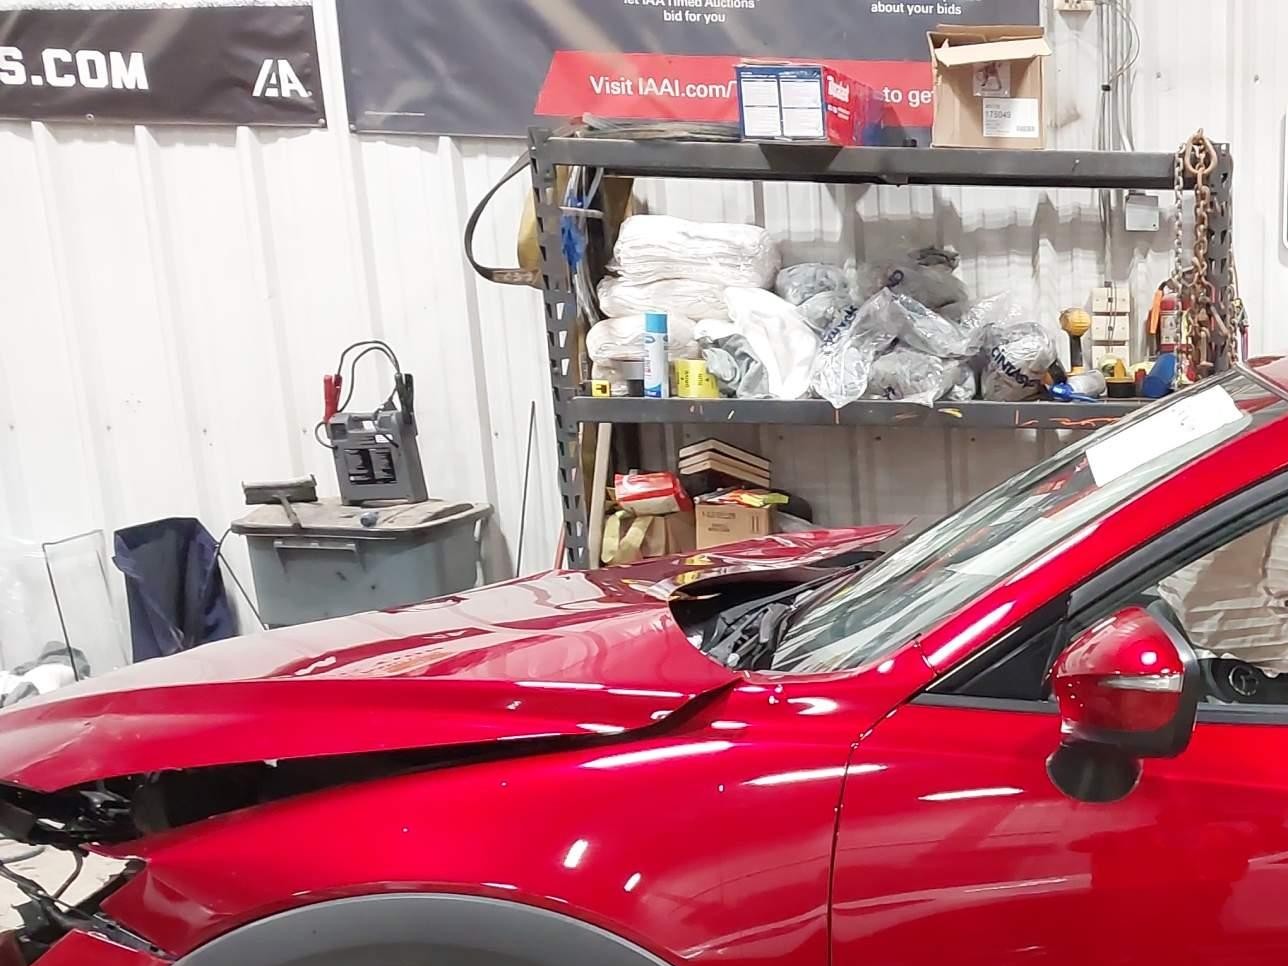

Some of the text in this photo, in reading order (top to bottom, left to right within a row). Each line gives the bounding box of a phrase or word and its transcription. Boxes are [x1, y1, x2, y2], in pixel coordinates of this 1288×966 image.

[663, 10, 726, 25] bid for you
[871, 1, 962, 16] about your bids
[0, 46, 149, 89] S.COM
[589, 76, 634, 95] Visit
[882, 86, 934, 108] to ge
